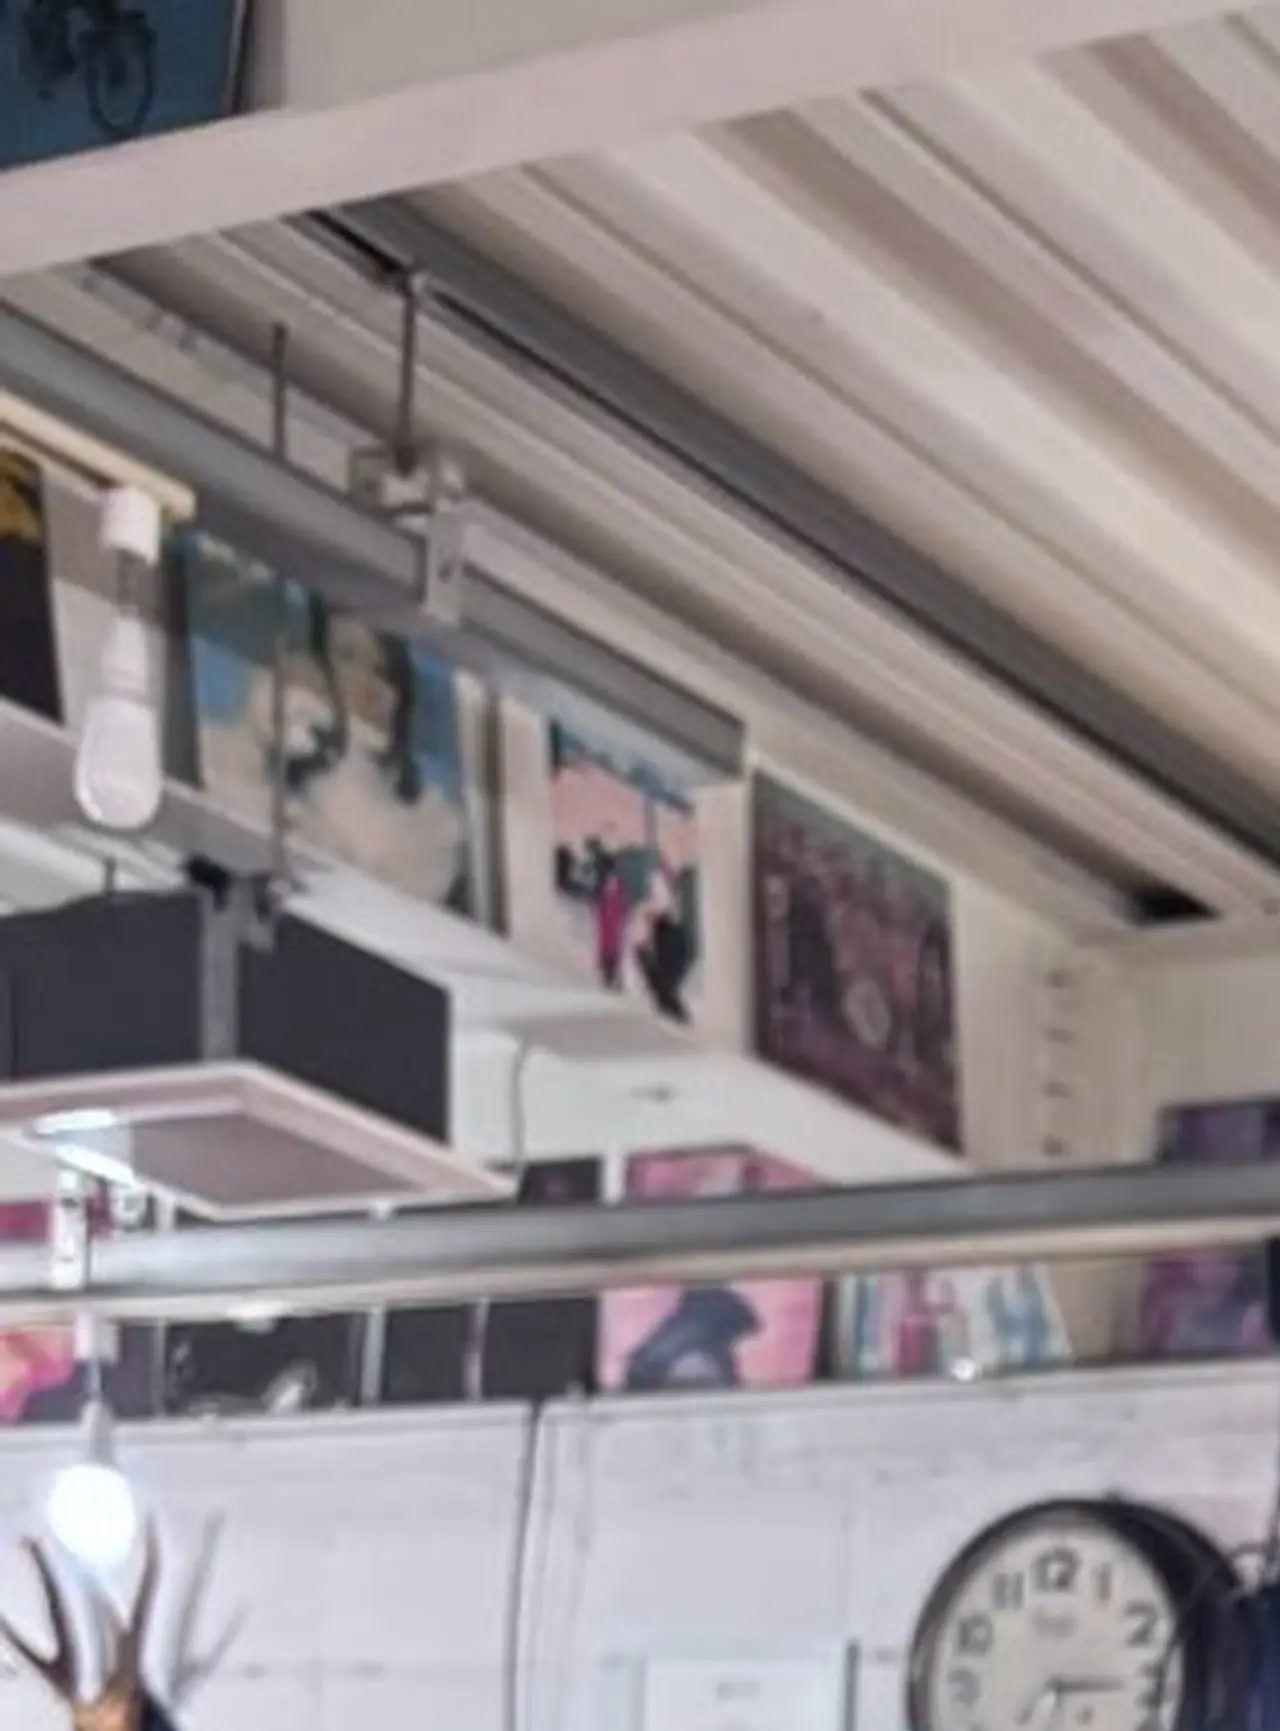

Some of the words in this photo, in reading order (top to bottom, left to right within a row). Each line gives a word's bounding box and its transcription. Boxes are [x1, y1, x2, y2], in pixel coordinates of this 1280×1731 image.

[994, 1571, 1026, 1610] 11
[1033, 1548, 1079, 1592] 12
[1094, 1560, 1113, 1603] 1
[957, 1613, 994, 1655] 10
[1124, 1602, 1159, 1647] 2
